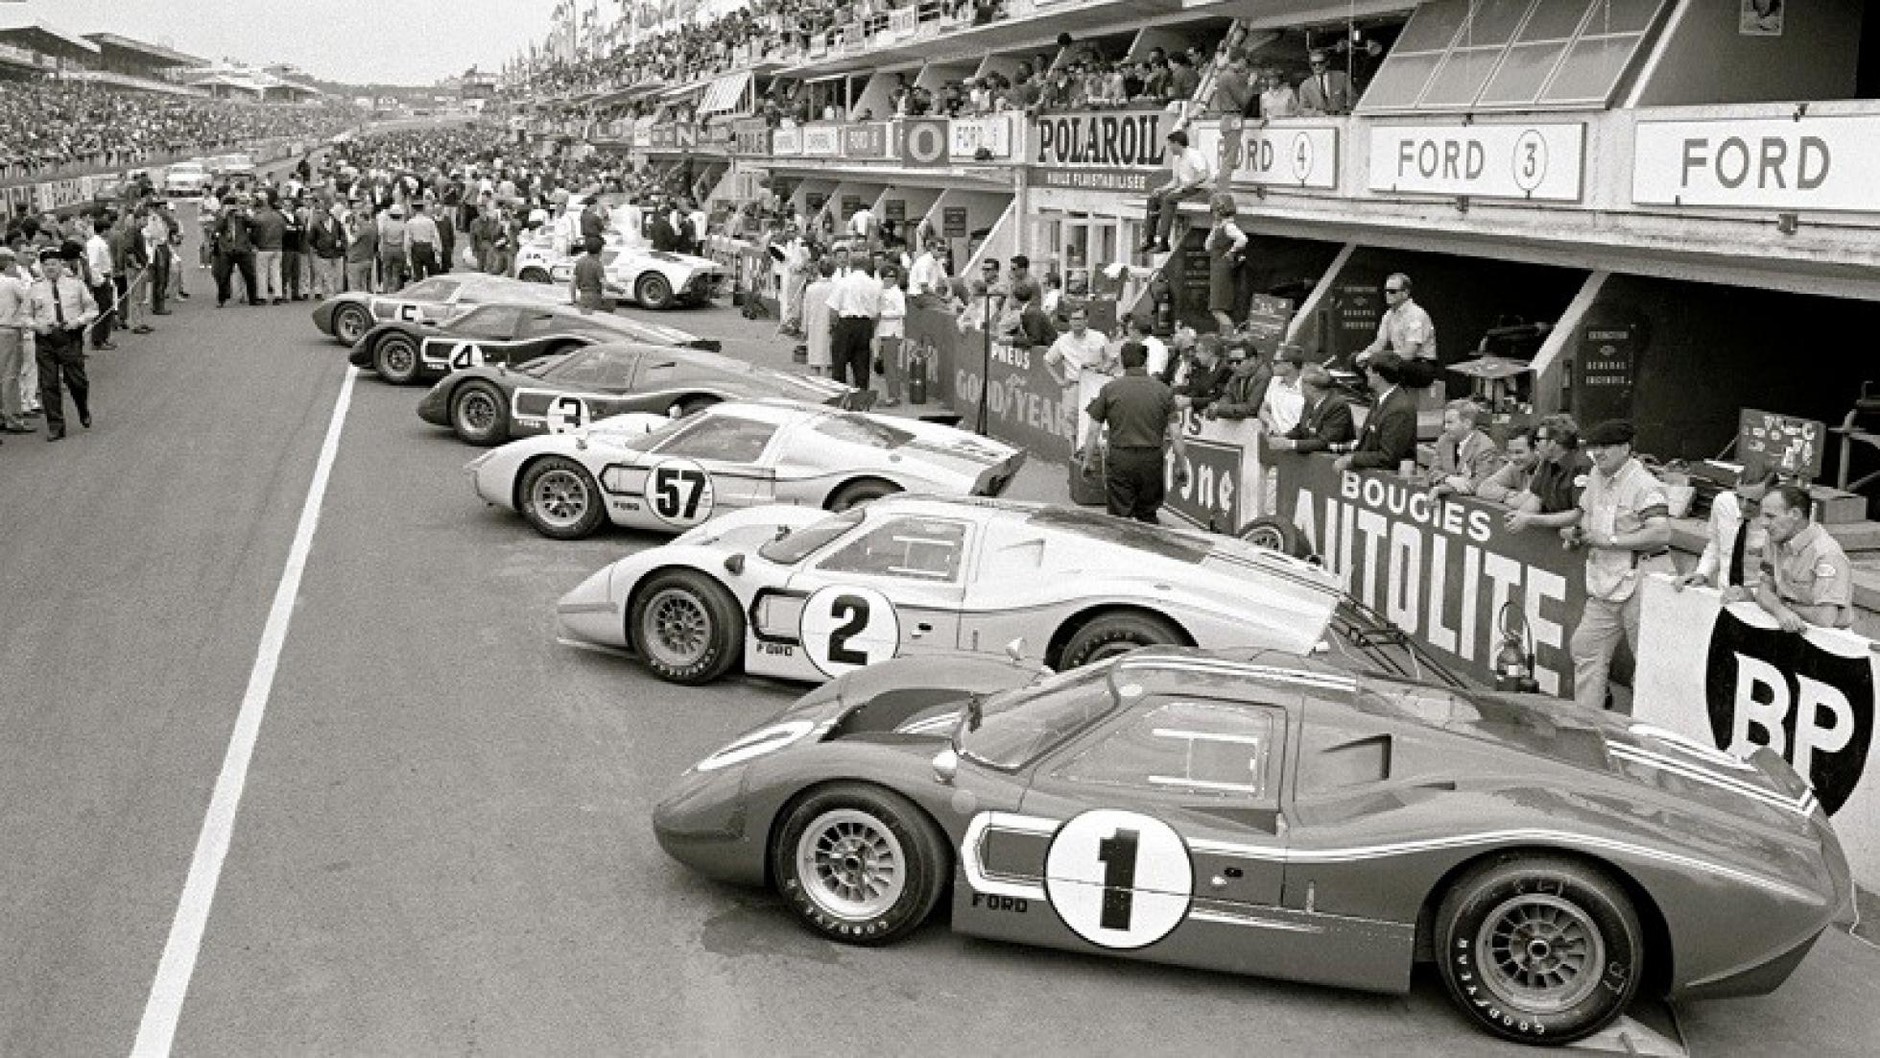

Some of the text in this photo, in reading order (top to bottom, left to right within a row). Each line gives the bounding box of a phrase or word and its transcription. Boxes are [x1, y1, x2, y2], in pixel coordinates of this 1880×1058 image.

[1037, 114, 1166, 165] POLAROIL
[1296, 142, 1307, 171] 4
[1397, 139, 1538, 181] FORD 3
[1681, 135, 1832, 190] FORD
[453, 345, 474, 369] 4
[557, 396, 582, 434] 3
[655, 467, 707, 519] 57
[1341, 469, 1492, 542] BOUGIES
[827, 594, 871, 666] 2
[1730, 651, 1855, 787] BP
[972, 892, 1028, 912] FORD
[1097, 826, 1141, 932] 1
